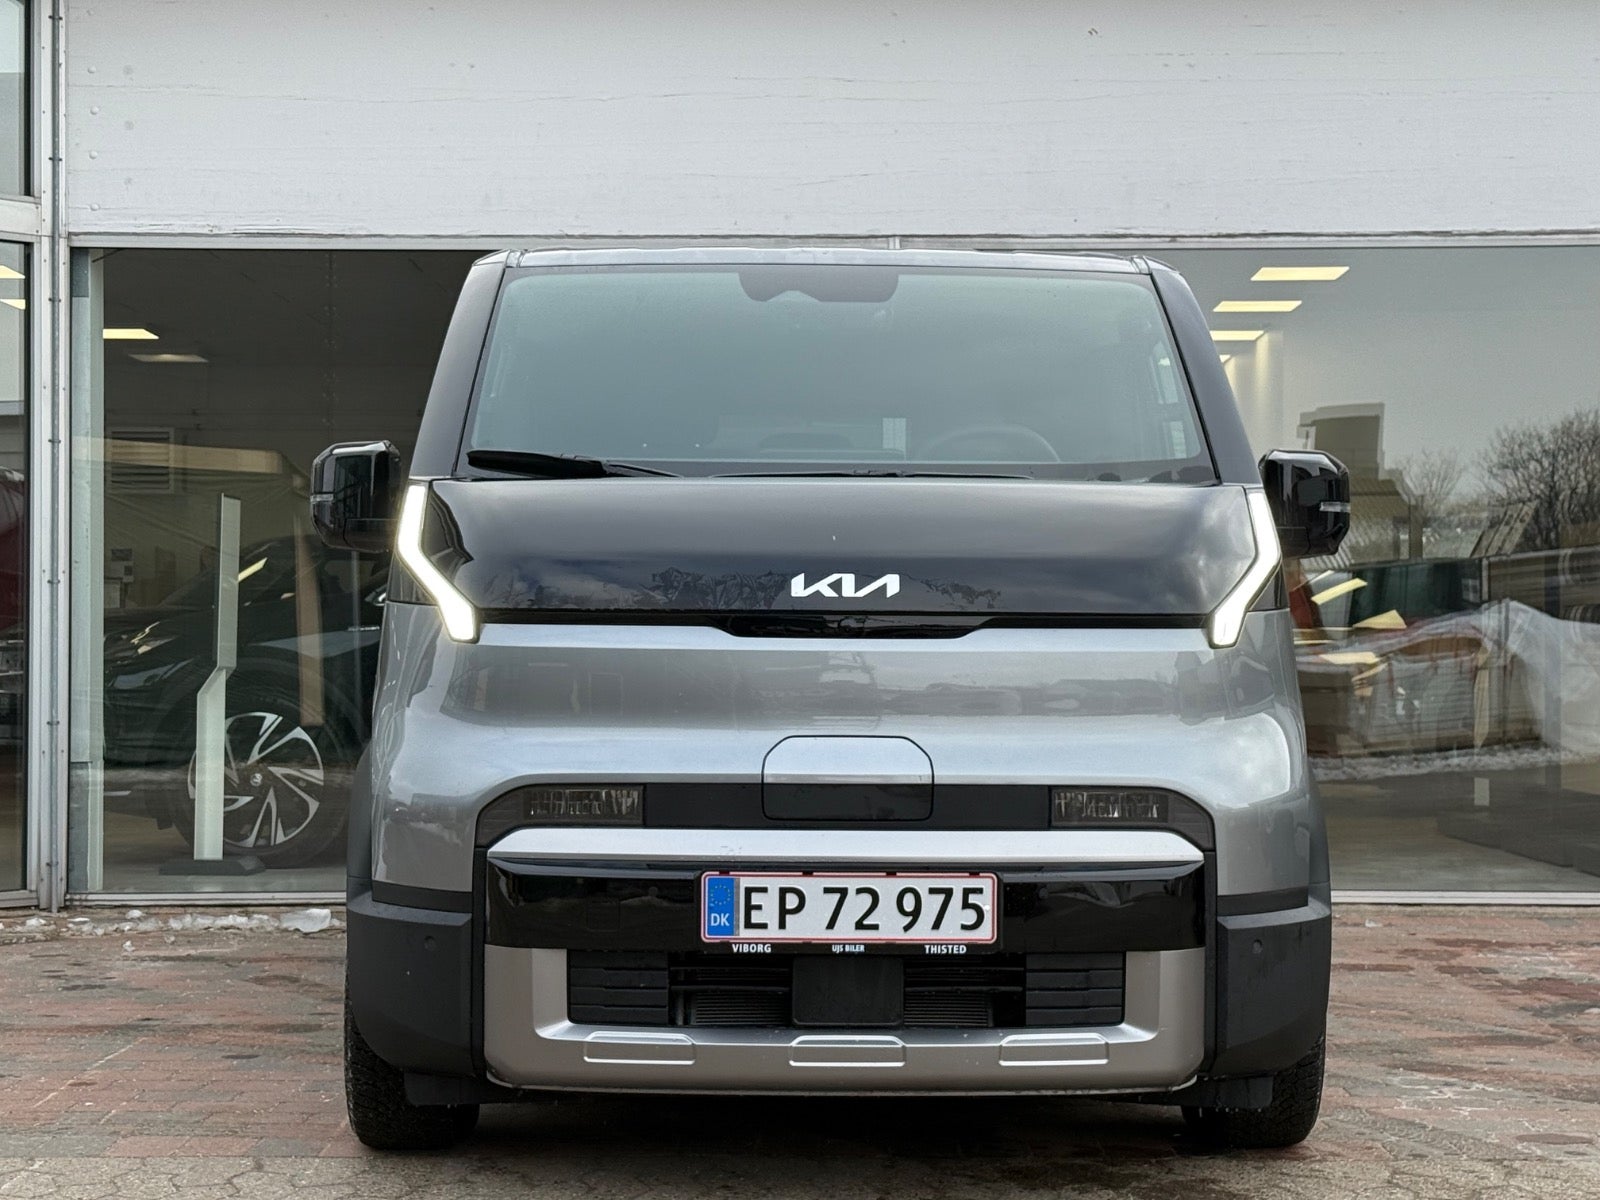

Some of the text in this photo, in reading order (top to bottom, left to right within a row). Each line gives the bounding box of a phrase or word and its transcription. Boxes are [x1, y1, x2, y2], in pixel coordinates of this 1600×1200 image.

[790, 572, 900, 598] KIA
[743, 886, 985, 932] EP 72 975
[710, 913, 730, 927] DK
[732, 943, 772, 953] VIBORG
[924, 944, 967, 955] THISTED
